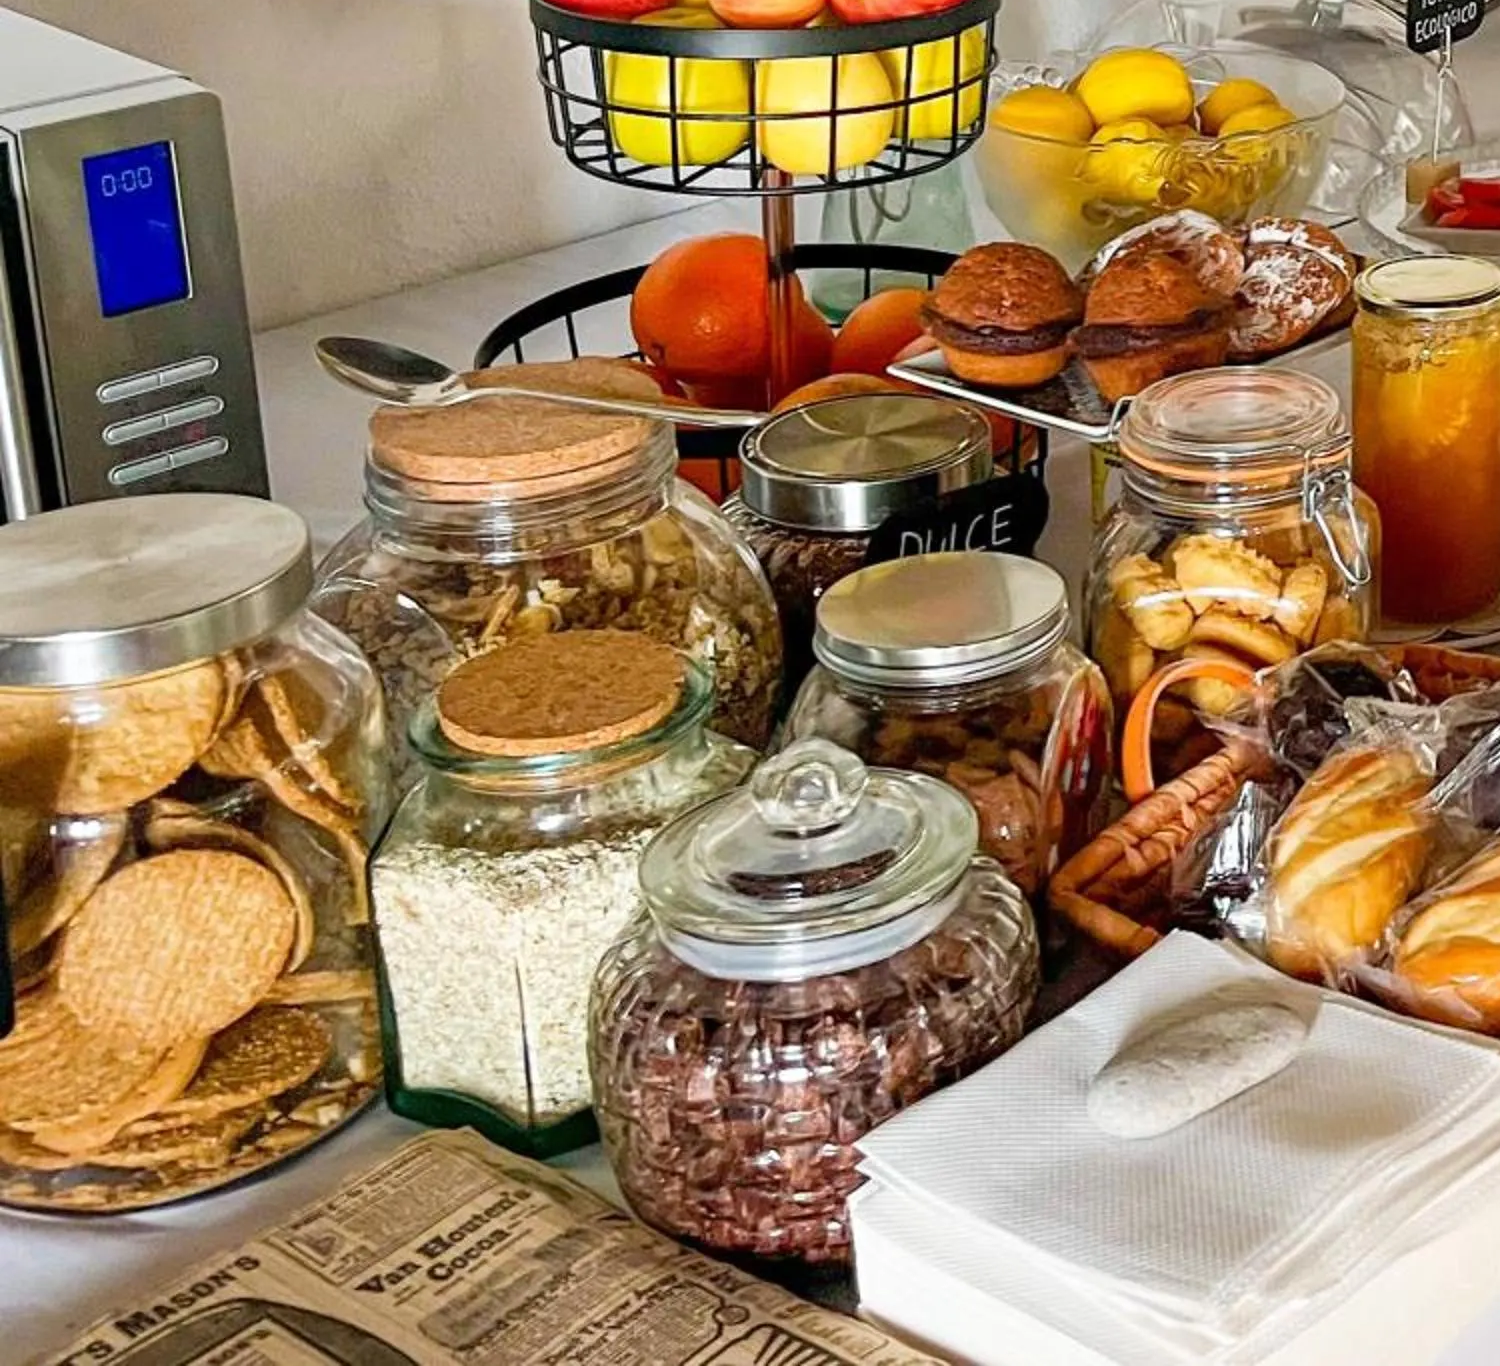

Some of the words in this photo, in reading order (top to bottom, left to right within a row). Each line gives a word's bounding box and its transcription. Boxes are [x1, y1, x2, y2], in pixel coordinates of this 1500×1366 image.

[101, 165, 153, 197] 0:00
[354, 1260, 423, 1293] Van
[415, 1188, 533, 1259] Houten's
[425, 1228, 512, 1281] Cocoa
[114, 1254, 262, 1338] MASON'S
